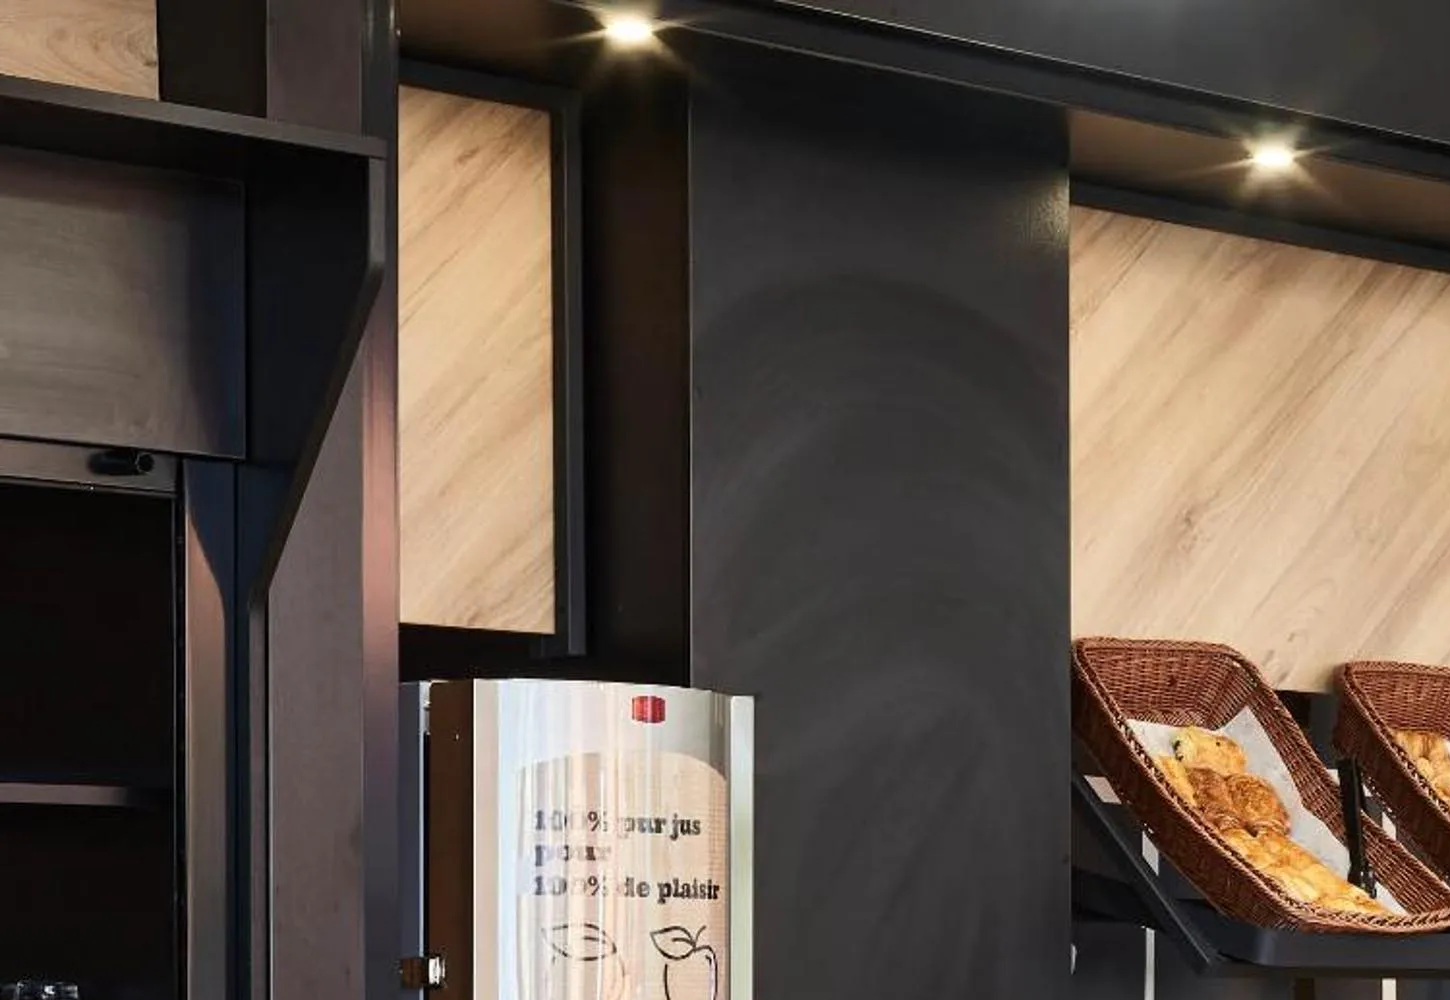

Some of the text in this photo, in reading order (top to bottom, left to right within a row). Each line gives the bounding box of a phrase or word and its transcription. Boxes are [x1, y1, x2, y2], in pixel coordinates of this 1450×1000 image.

[617, 817, 667, 839] pur
[670, 813, 701, 841] jus
[618, 877, 650, 898] de
[657, 877, 721, 904] plaisir
